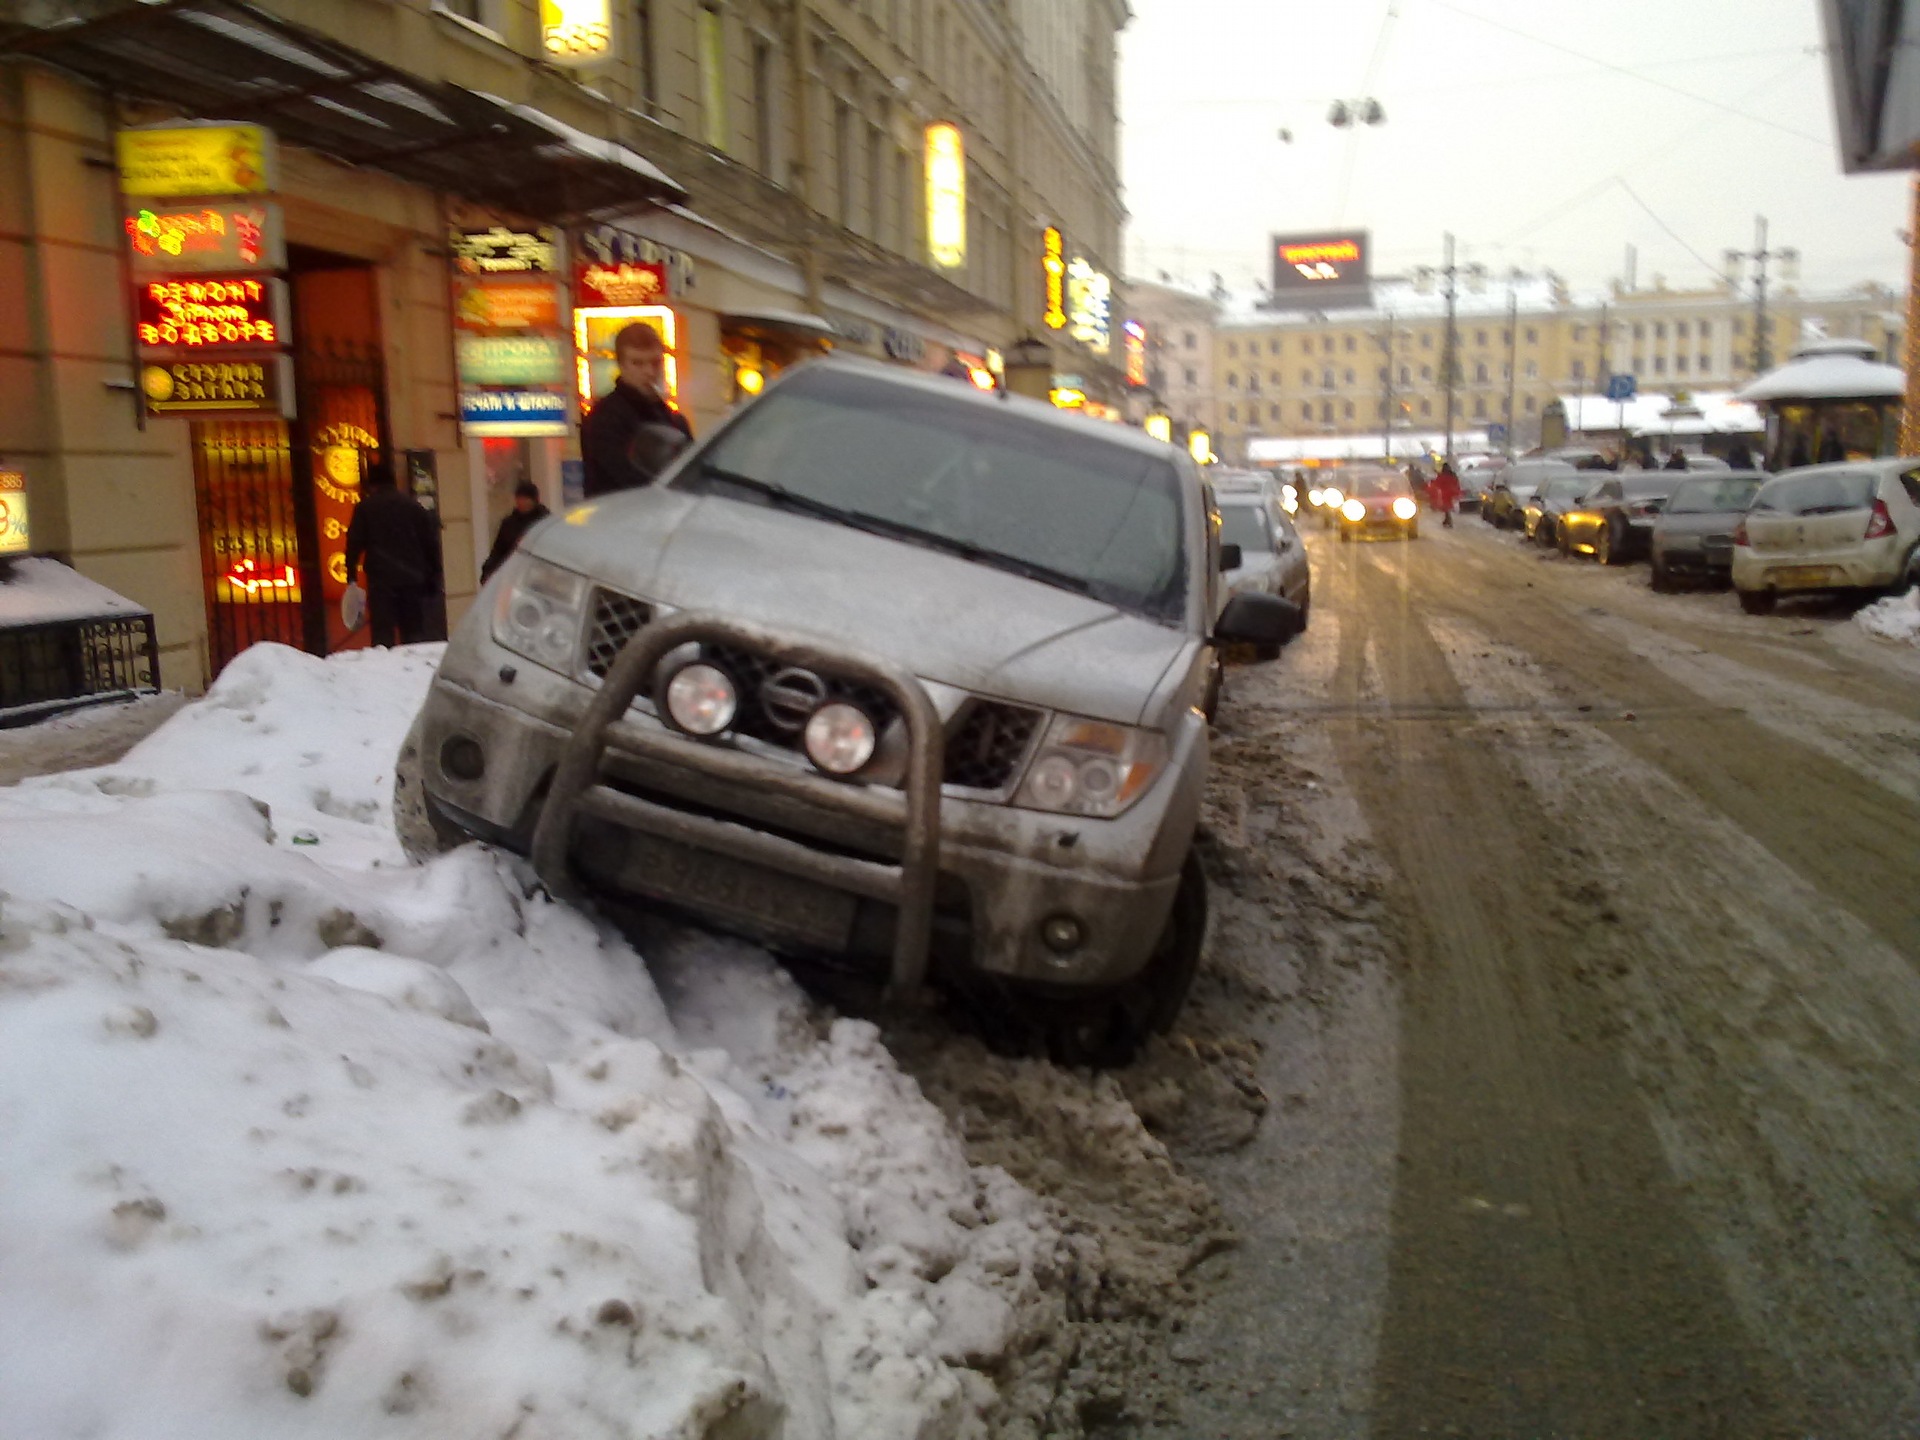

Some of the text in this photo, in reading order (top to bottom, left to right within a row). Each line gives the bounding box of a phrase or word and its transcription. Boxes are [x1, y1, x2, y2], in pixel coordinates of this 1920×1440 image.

[150, 280, 263, 302] РЕМОНТ
[139, 319, 275, 345] ВО ДВОРЕ
